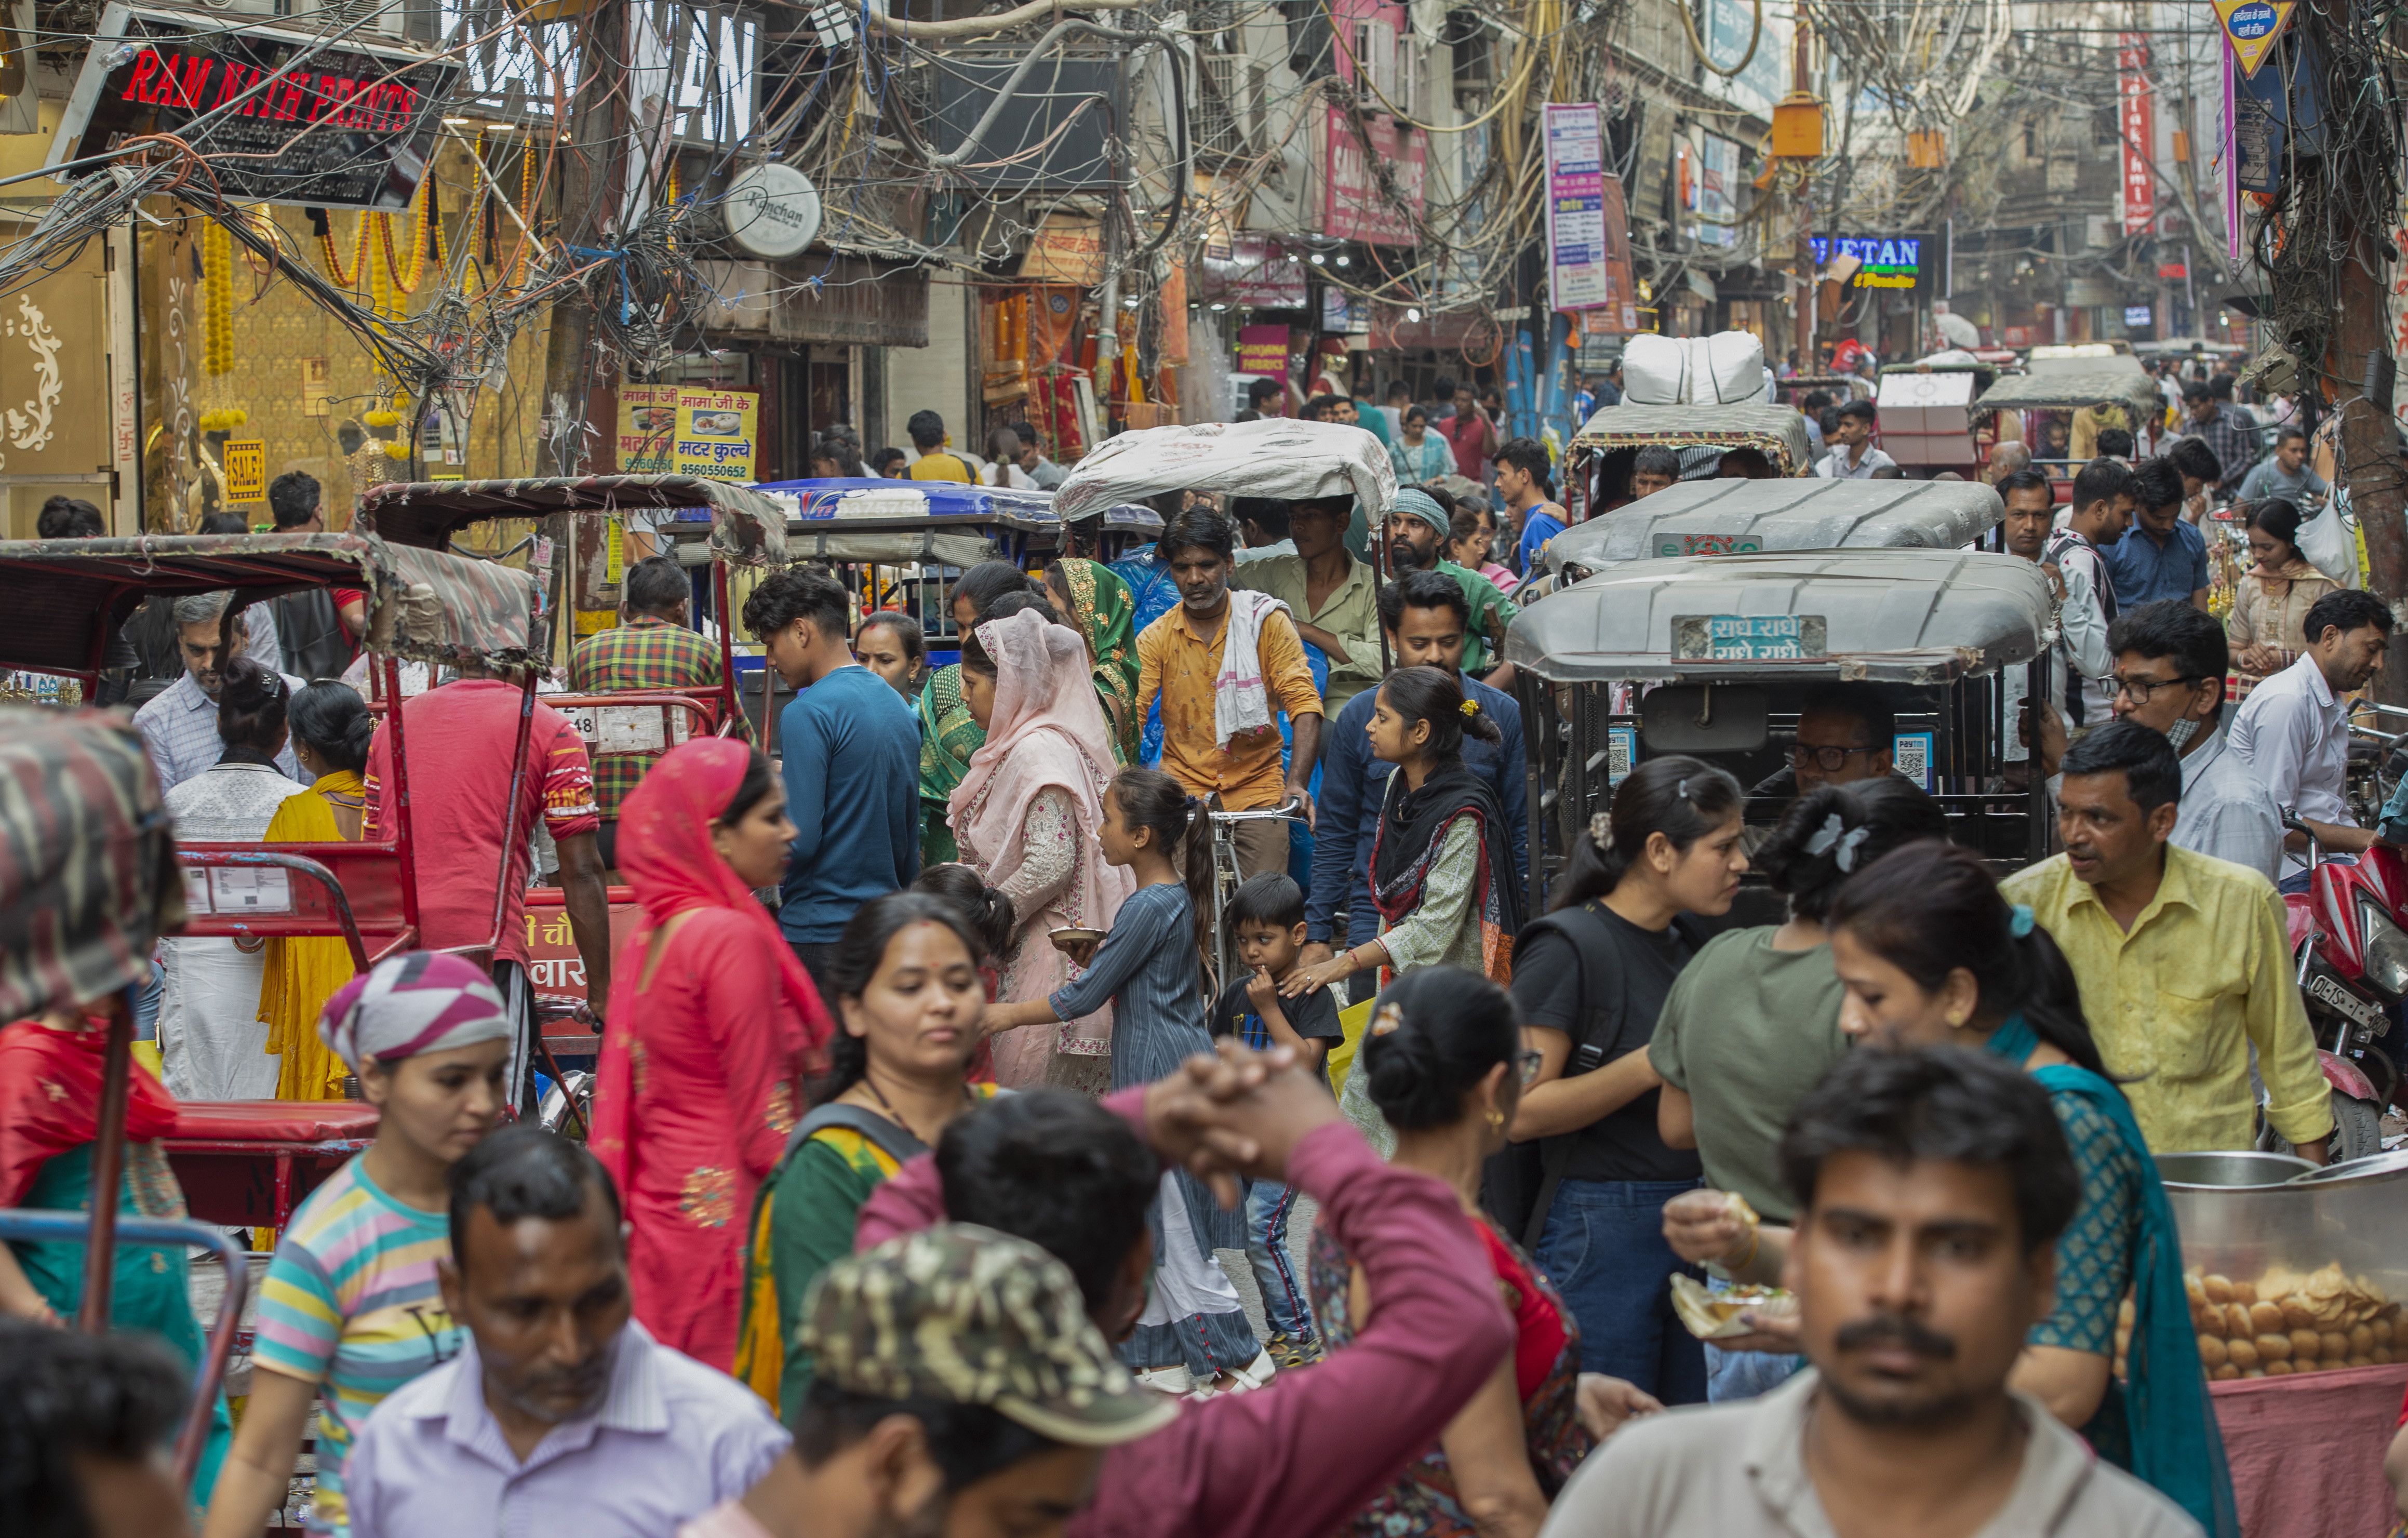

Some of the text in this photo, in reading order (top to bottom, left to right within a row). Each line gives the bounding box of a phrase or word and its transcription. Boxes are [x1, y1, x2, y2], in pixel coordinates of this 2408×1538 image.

[122, 49, 213, 110] RAM
[211, 61, 311, 122] NATH
[306, 76, 419, 132] PRINTS
[745, 191, 803, 222] Kanchan
[681, 394, 751, 411] मामा जी के
[678, 440, 712, 457] मटर
[714, 438, 751, 463] कुल्चे
[232, 456, 258, 487] SALE
[681, 463, 746, 477] 9560550652
[1716, 615, 1797, 637] राधे राधे
[1715, 639, 1799, 659] राधे राधे
[542, 912, 573, 945] चौ
